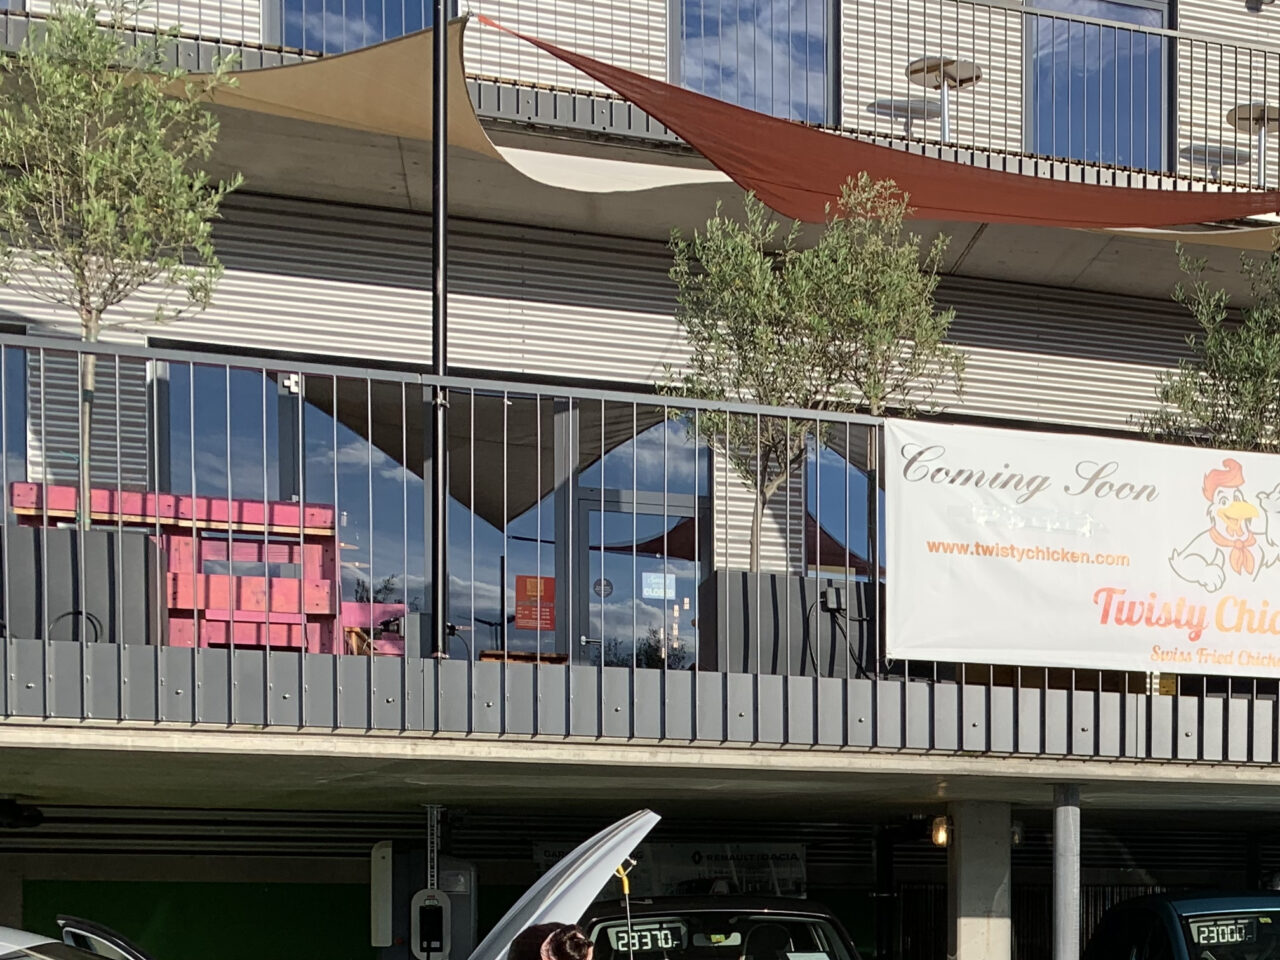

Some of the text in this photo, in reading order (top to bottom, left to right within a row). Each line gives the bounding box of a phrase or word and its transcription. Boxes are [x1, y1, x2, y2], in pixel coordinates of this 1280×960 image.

[901, 443, 1159, 504] Coming Soon
[926, 540, 1130, 567] www.twistychicken.com
[1092, 587, 1209, 642] Twisty
[1150, 644, 1193, 663] Swiss
[1196, 646, 1234, 666] Fried
